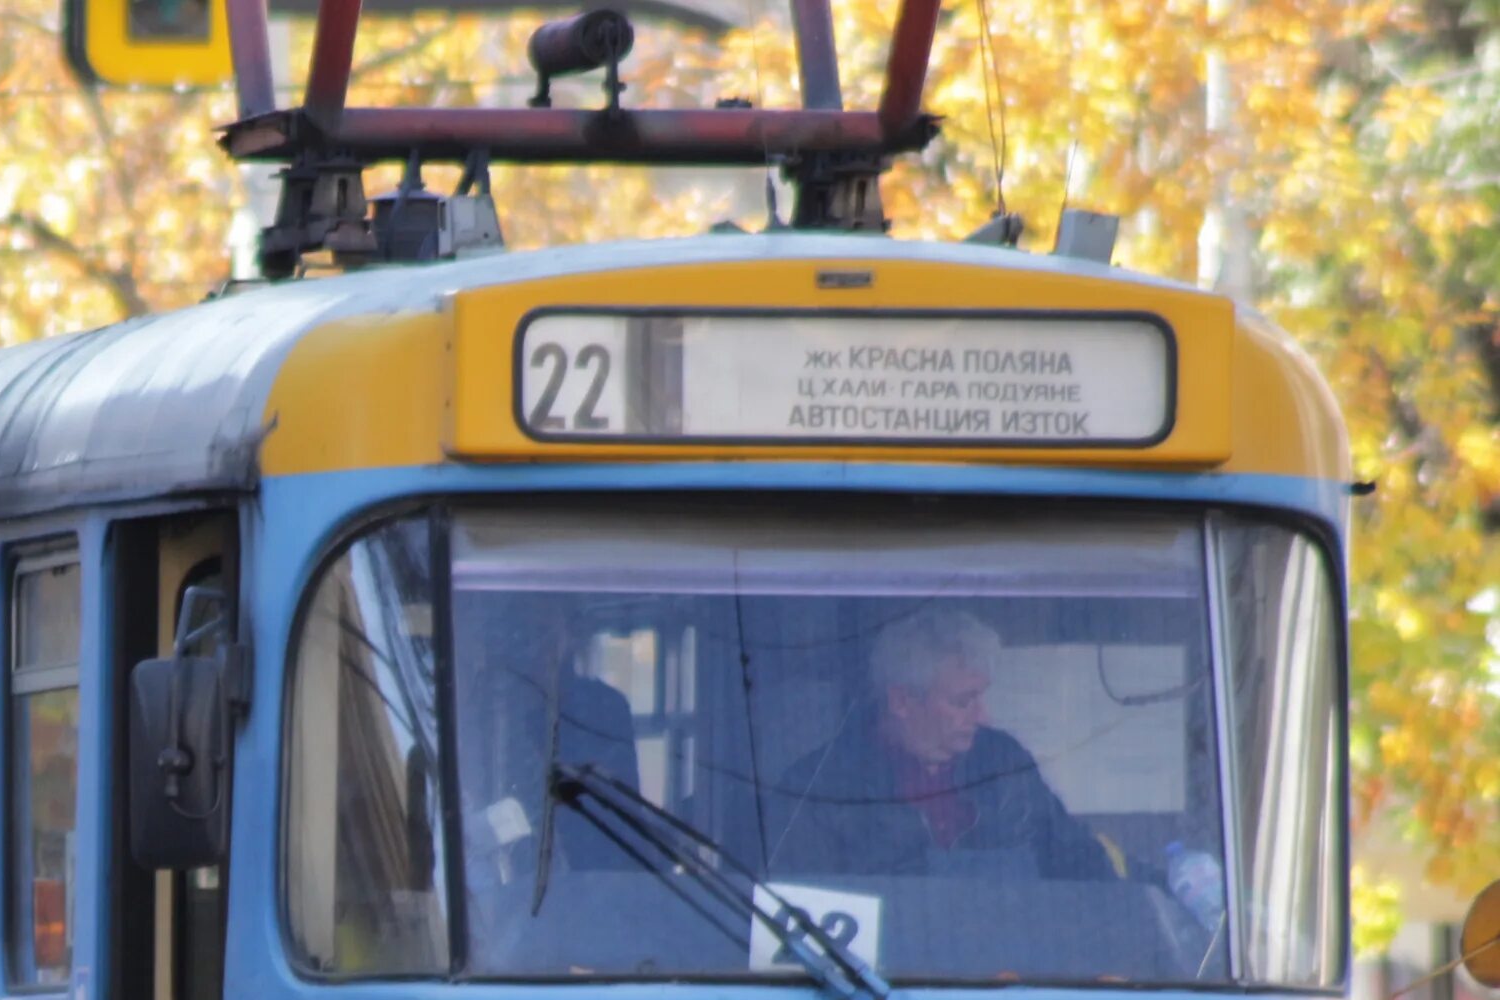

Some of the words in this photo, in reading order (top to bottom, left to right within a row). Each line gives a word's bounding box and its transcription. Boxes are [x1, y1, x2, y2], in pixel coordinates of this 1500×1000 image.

[848, 345, 955, 372] КРАСНА
[964, 349, 1072, 375] ПОЛЯНА
[529, 341, 611, 430] 22
[822, 378, 886, 398] ХАЛИ
[901, 380, 959, 399] ГАРА
[967, 381, 1081, 403] ПОДУЯНЕ
[787, 404, 991, 433] АВТОСТАНЦИЯ
[1001, 410, 1090, 436] ИЗТОК
